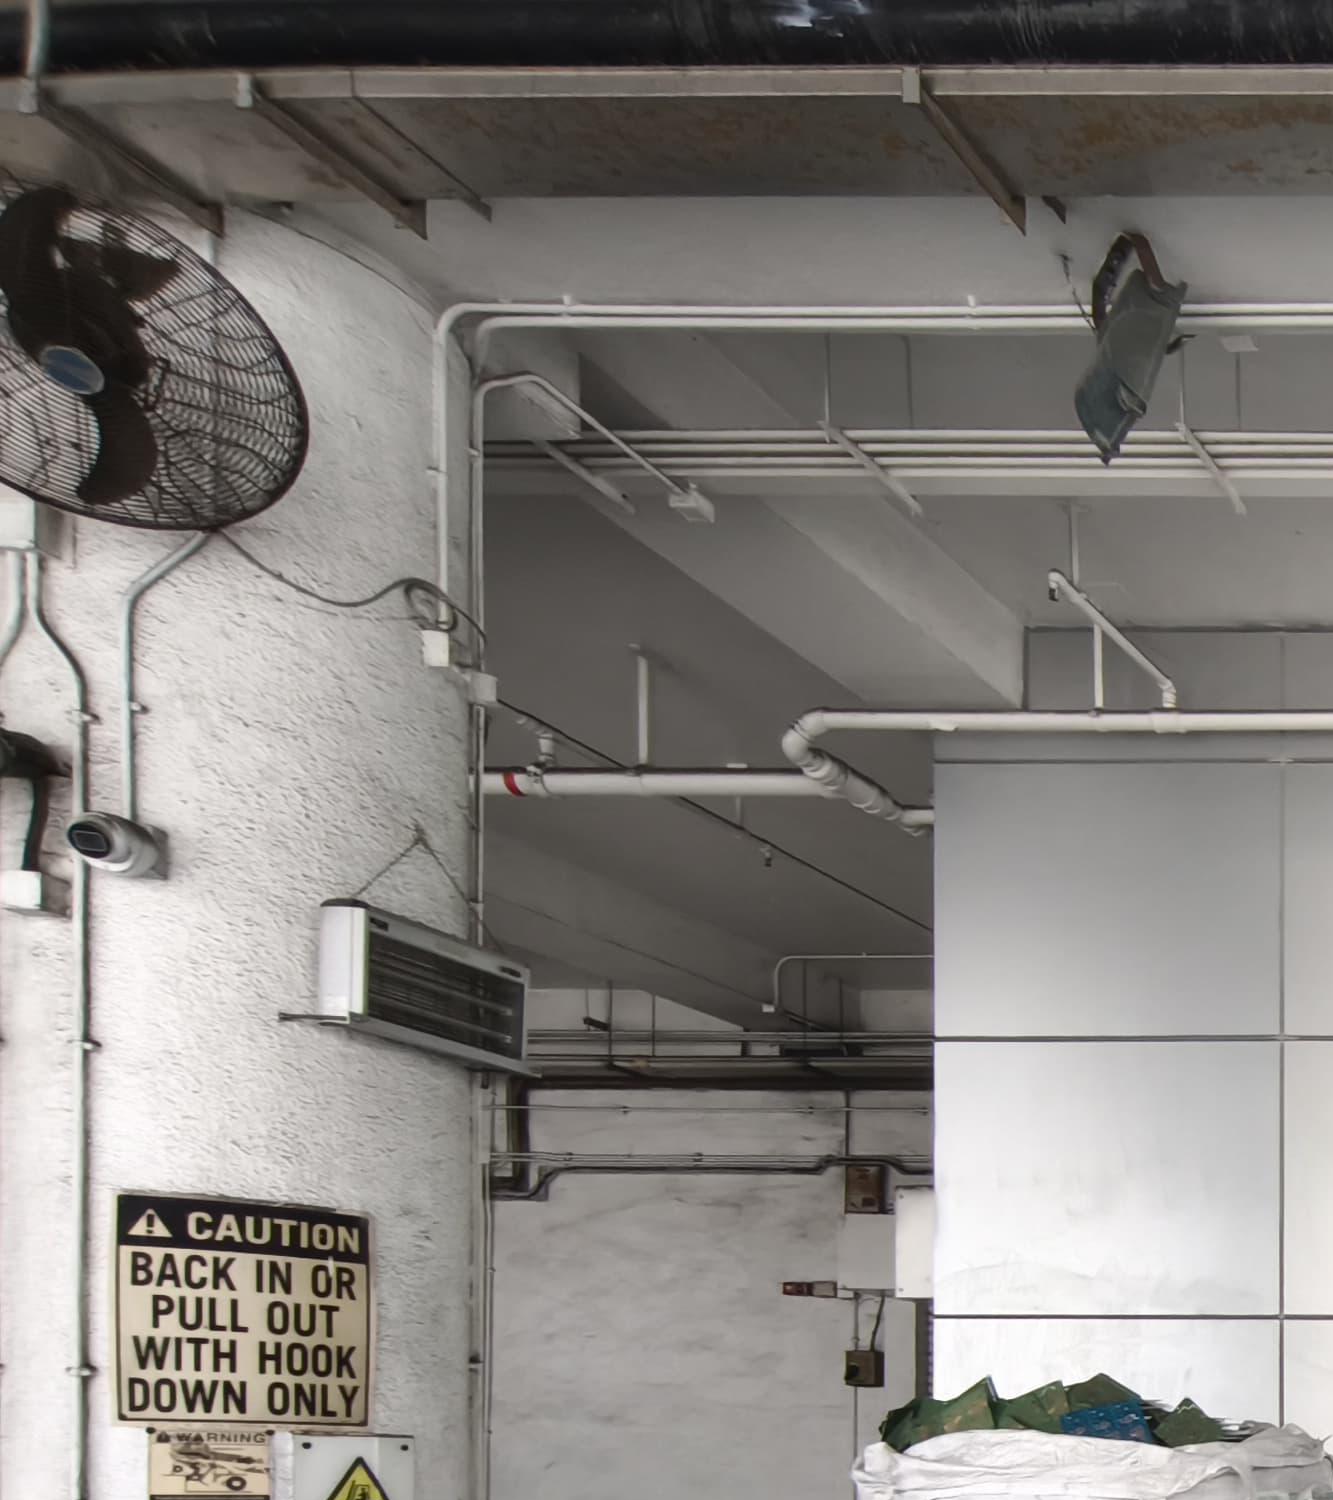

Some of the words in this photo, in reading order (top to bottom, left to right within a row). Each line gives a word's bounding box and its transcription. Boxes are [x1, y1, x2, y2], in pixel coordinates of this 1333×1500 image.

[187, 1211, 359, 1252] CAUTION
[130, 1251, 237, 1292] BACK
[255, 1259, 293, 1296] IN
[310, 1264, 357, 1301] OR
[152, 1294, 249, 1333] PULL
[266, 1300, 341, 1339] OUT
[132, 1335, 237, 1374] WITH
[258, 1340, 358, 1380] HOOK
[128, 1377, 247, 1415] DOWN
[267, 1381, 361, 1419] ONLY
[176, 1432, 266, 1444] WARNING
